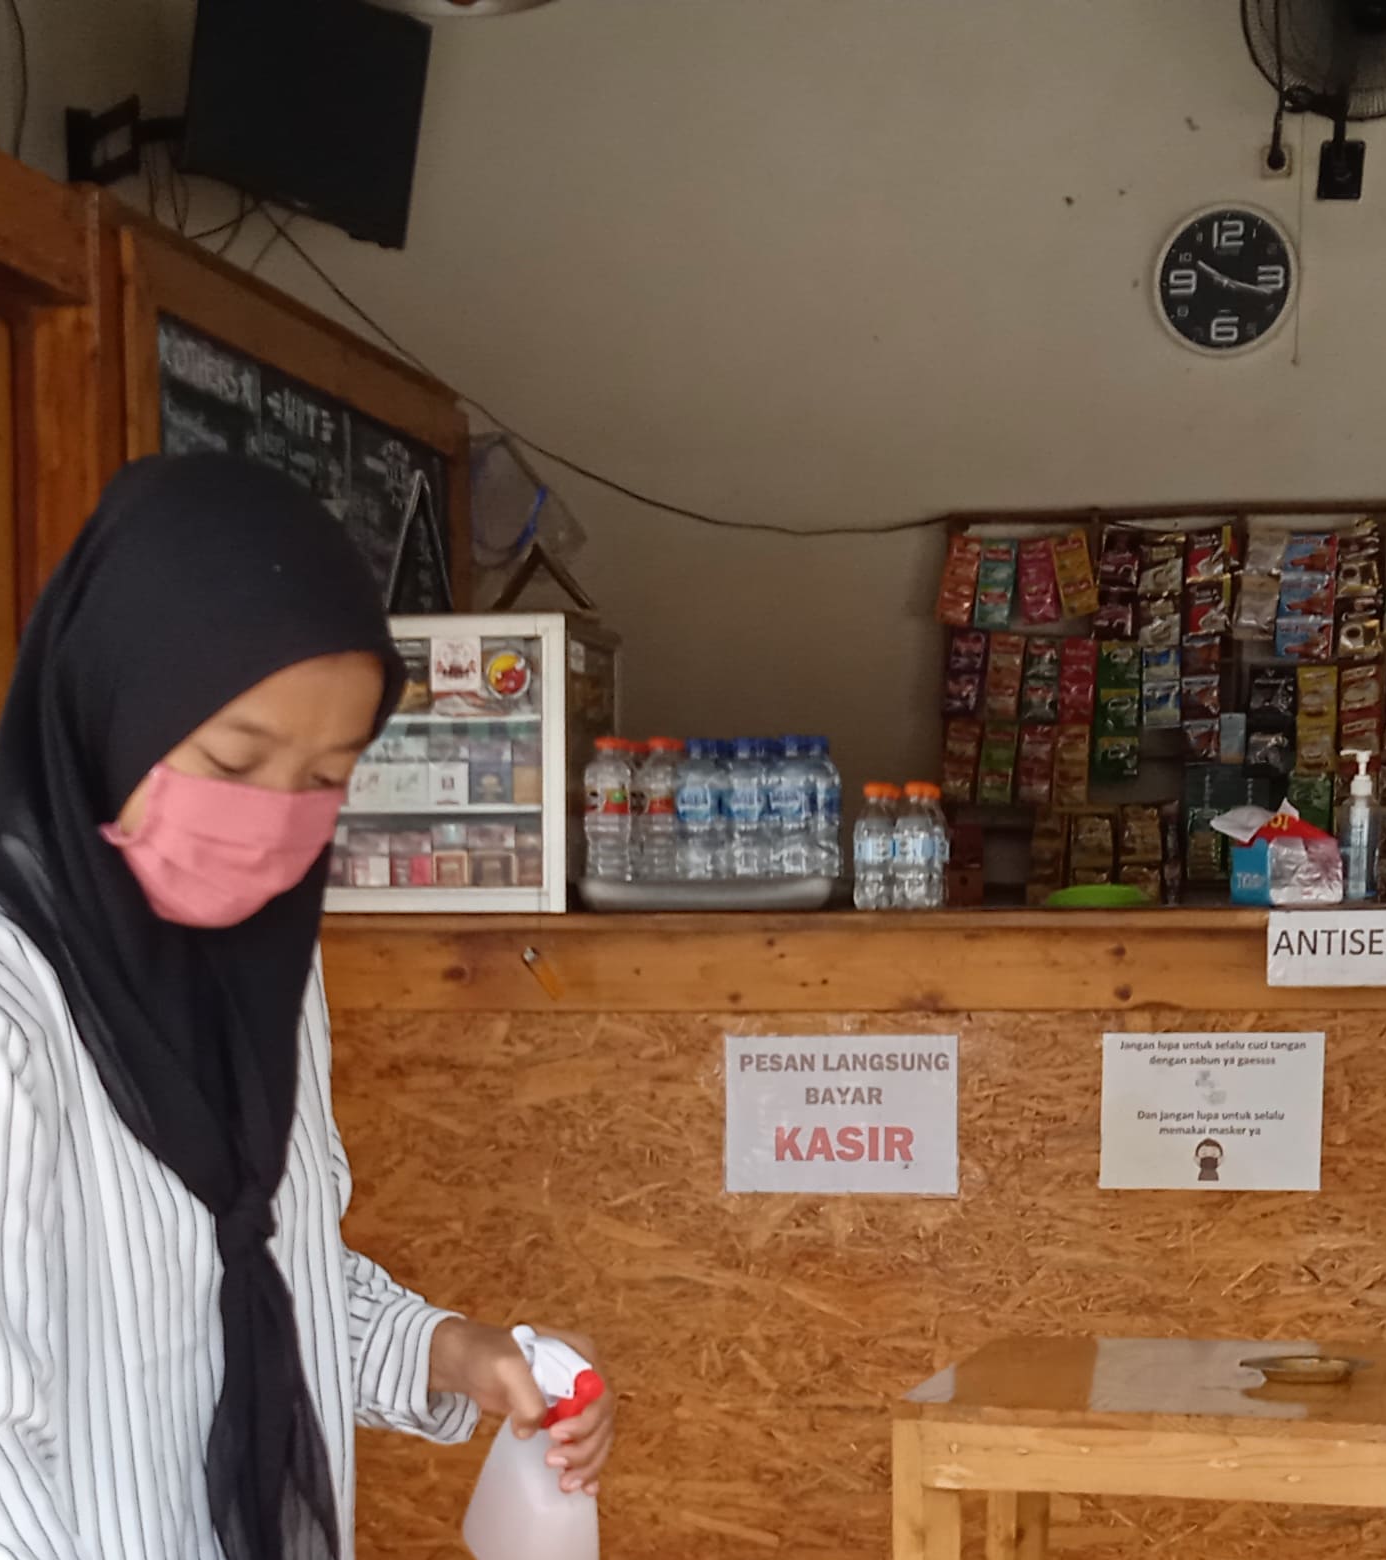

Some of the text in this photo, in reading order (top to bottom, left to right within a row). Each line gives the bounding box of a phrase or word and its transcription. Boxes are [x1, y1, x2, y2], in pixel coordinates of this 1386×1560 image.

[1212, 219, 1245, 249] 12
[1168, 269, 1198, 295] 9
[1257, 265, 1285, 290] 3
[1210, 315, 1240, 342] 6
[1157, 1040, 1180, 1051] lupa
[1182, 1040, 1213, 1050] untuk
[1215, 1040, 1245, 1050] selalu
[1270, 1040, 1307, 1051] tangan
[739, 1052, 950, 1073] PESAN LANGSUNG
[1149, 1055, 1187, 1066] dengan
[1189, 1055, 1221, 1065] sabun
[1223, 1057, 1235, 1067] ya
[805, 1086, 883, 1105] BAYAR
[1136, 1110, 1285, 1122] Dan jangan lupa untuk selalu
[1159, 1126, 1261, 1138] memakai masker ya
[774, 1125, 915, 1162] KASIR
